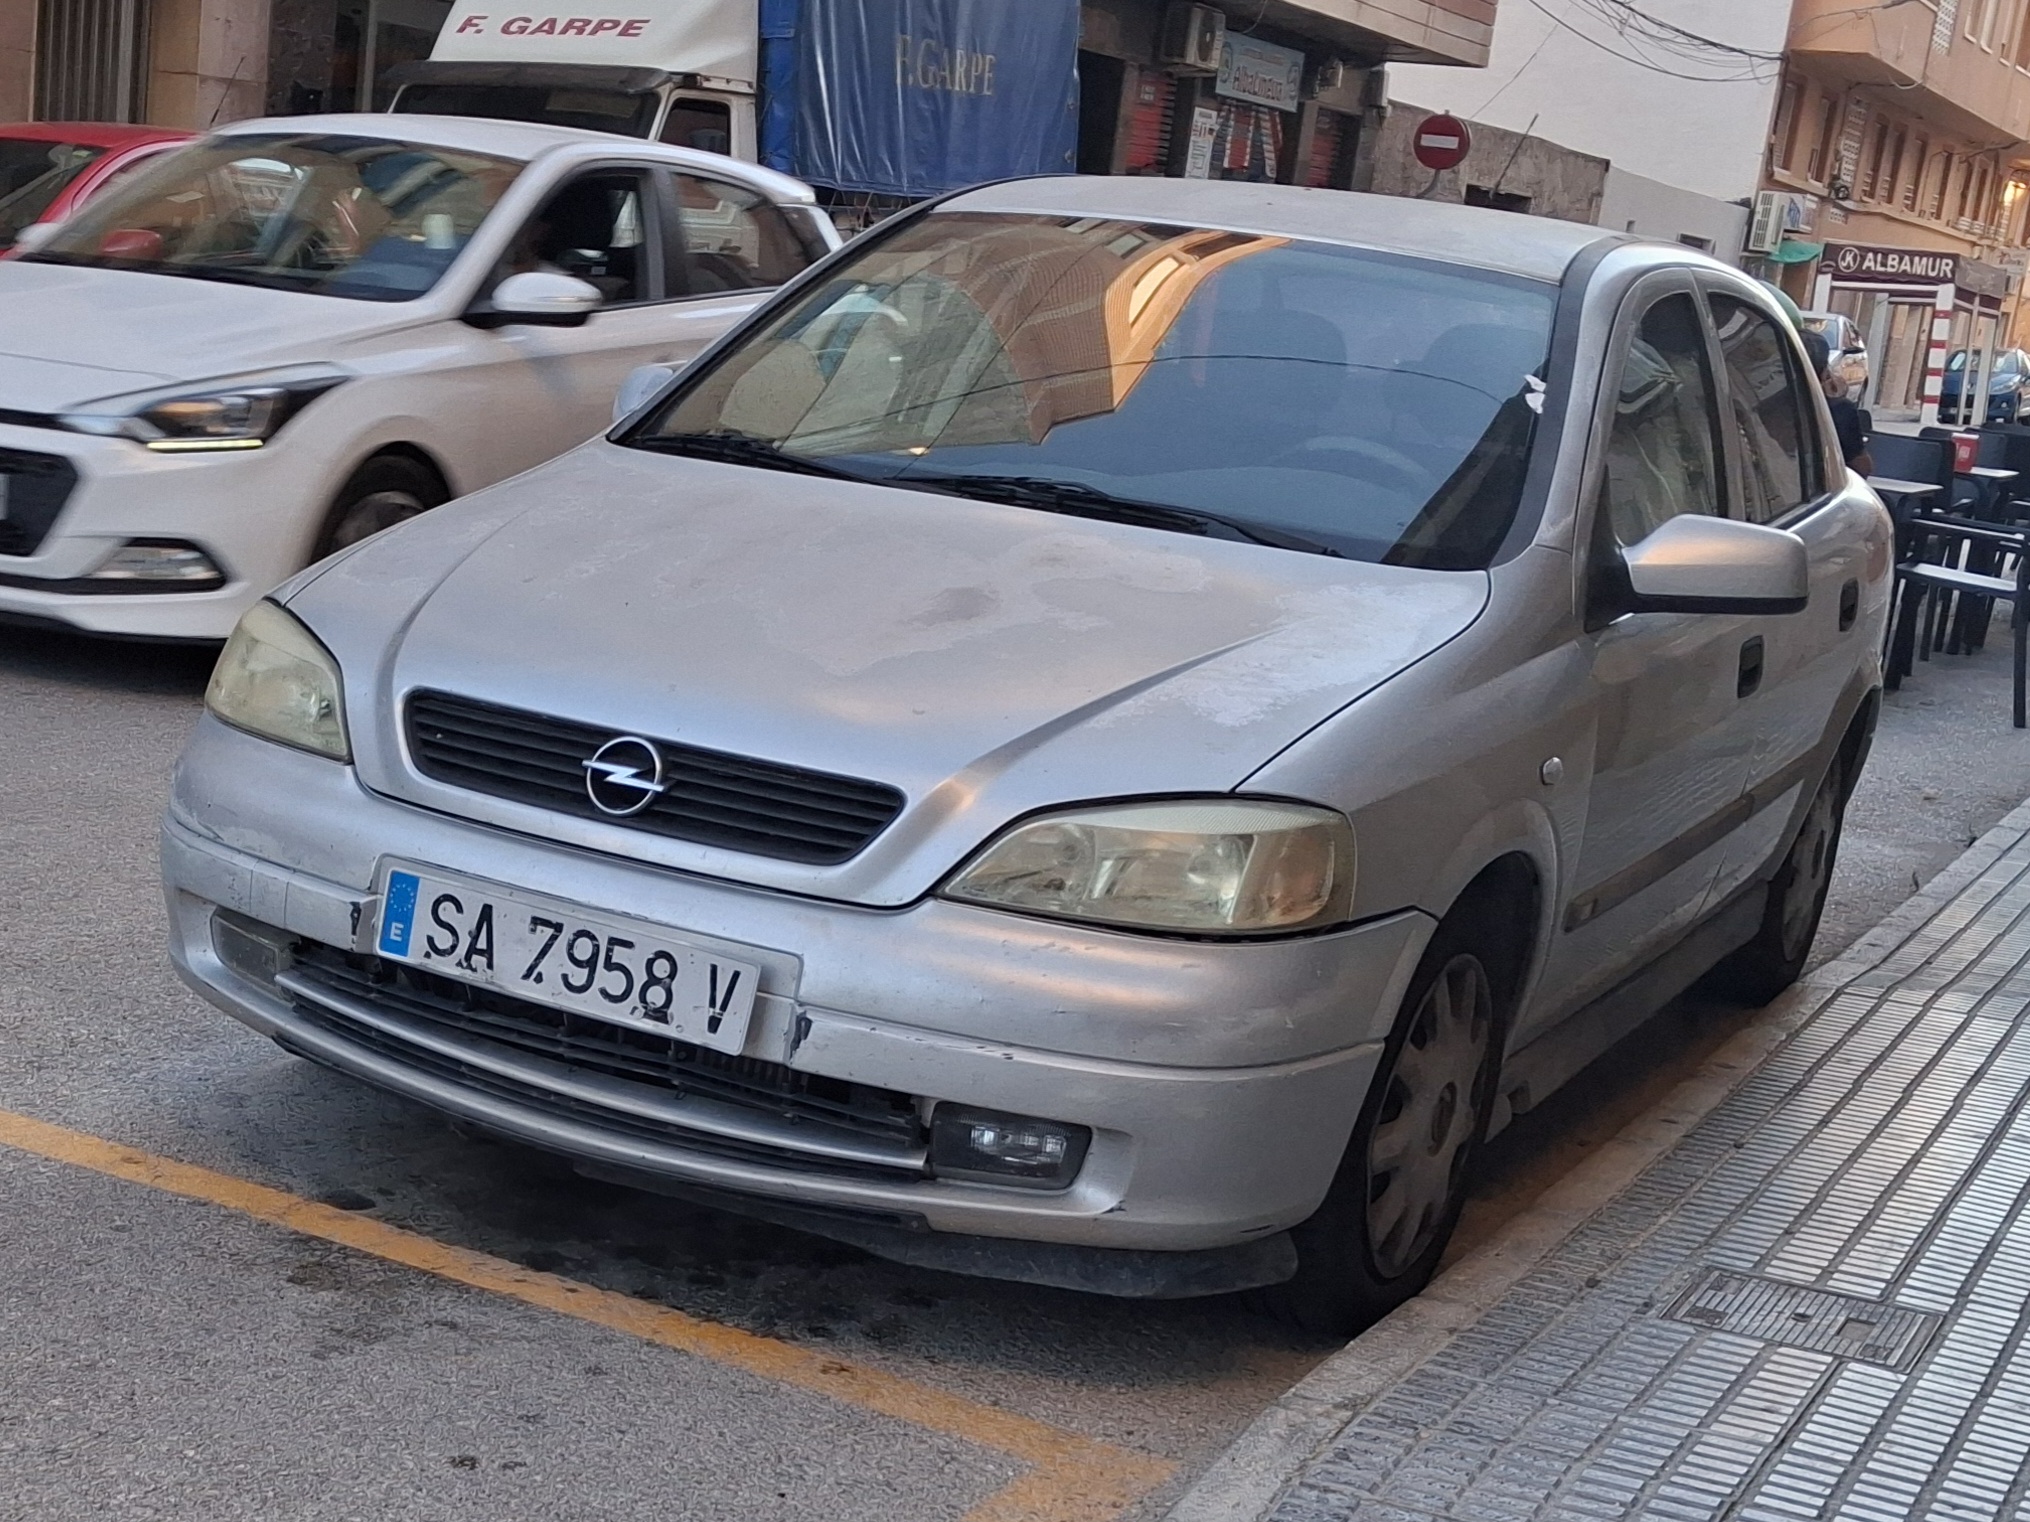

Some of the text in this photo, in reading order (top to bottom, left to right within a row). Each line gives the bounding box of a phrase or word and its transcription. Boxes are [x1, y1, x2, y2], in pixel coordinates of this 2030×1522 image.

[456, 15, 651, 38] F. GARPE
[1862, 252, 1954, 278] ALBAMUR
[390, 921, 404, 942] E
[424, 893, 742, 1034] SA 7958 V
